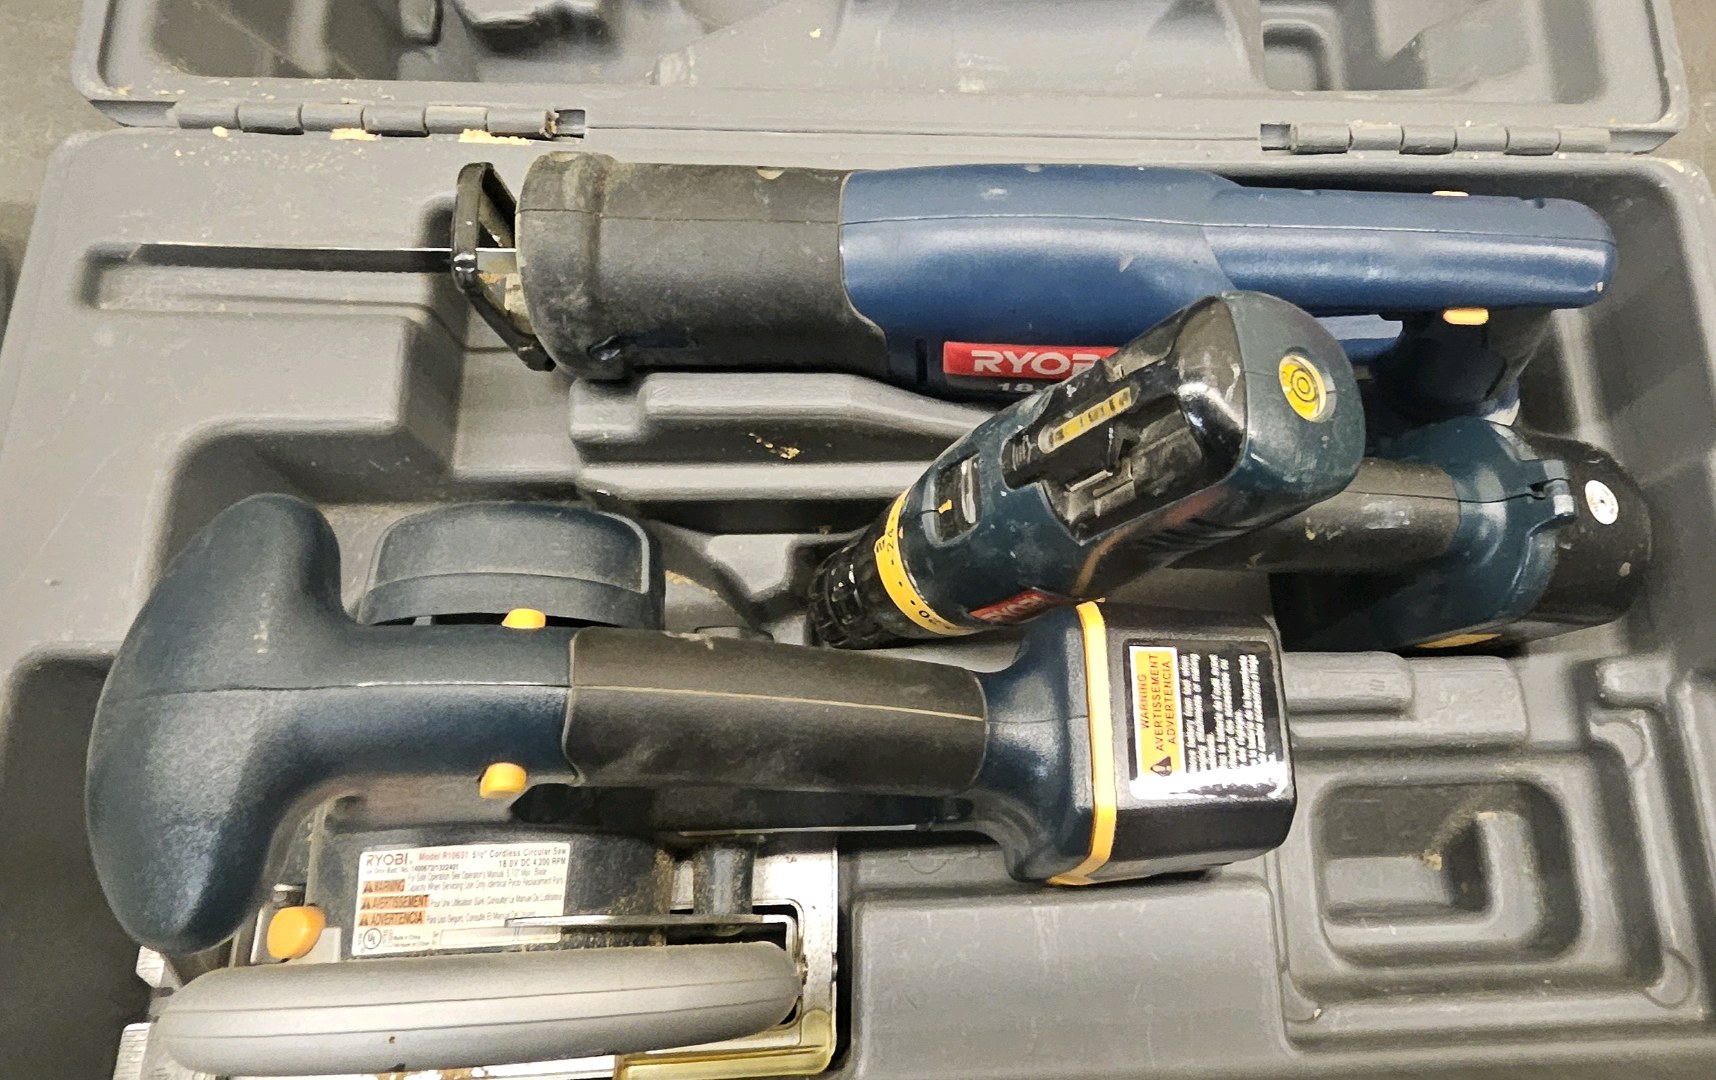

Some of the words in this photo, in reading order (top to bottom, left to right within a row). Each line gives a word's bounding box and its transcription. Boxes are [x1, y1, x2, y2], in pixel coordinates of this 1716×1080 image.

[971, 350, 1100, 375] RYOB
[998, 382, 1035, 393] 18
[1137, 674, 1150, 729] WARNING
[1149, 654, 1165, 751] AVERTISSEMENT
[1162, 661, 1177, 745] ADVERTENCIA
[366, 852, 409, 867] RYOBI
[418, 852, 439, 861] Model
[489, 849, 520, 858] Cordless
[523, 848, 551, 857] Circular
[553, 847, 567, 856] Saw
[499, 859, 518, 868] 18.0V
[521, 858, 531, 867] DC
[552, 857, 567, 866] RPM
[374, 880, 405, 892] WARNING
[373, 894, 429, 909] AVERTISSEMENT
[371, 911, 423, 926] ADVERTENCIA
